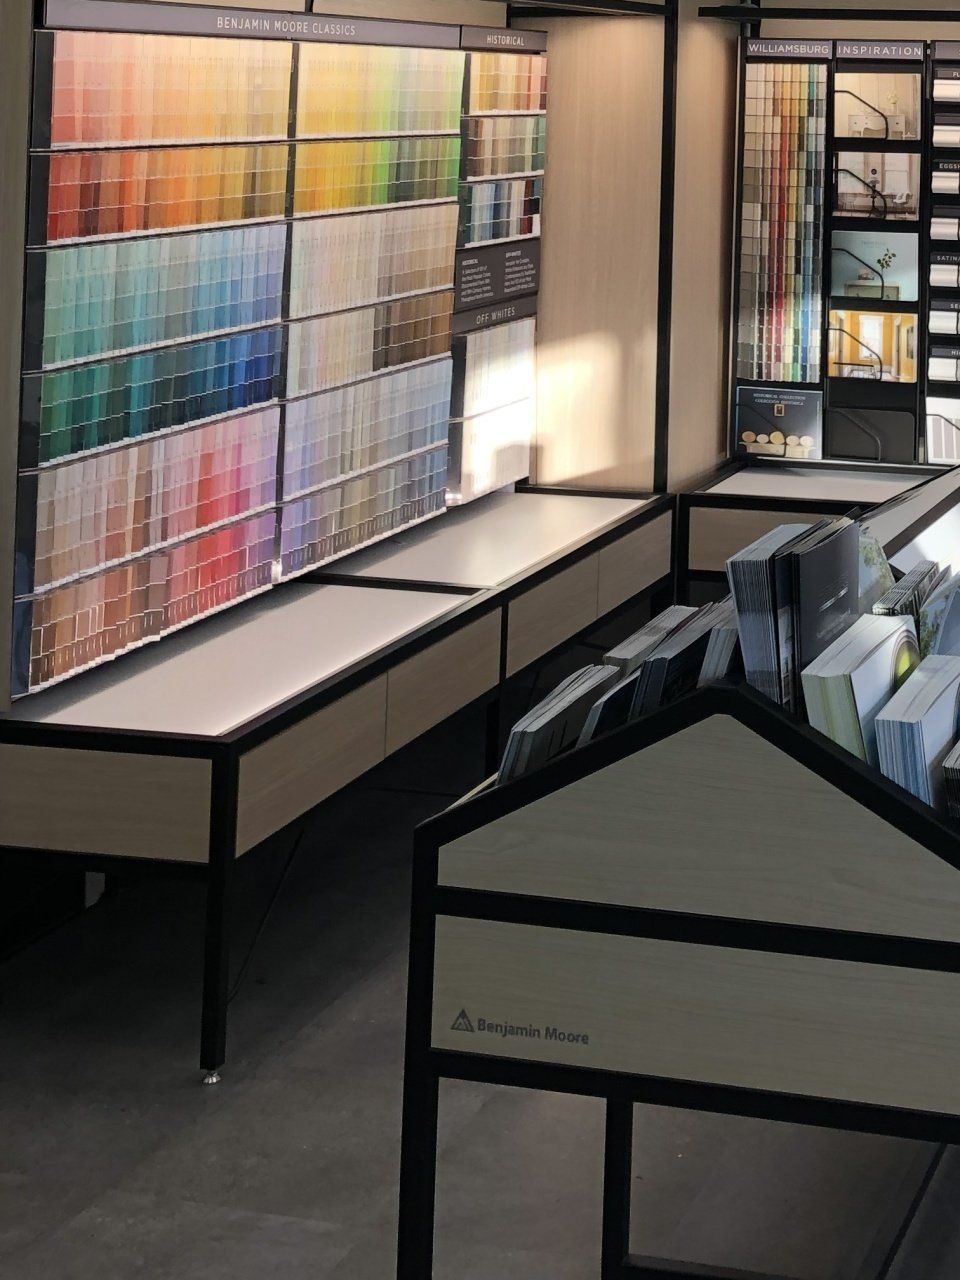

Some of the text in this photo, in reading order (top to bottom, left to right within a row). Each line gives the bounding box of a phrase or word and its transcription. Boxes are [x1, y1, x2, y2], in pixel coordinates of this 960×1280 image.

[217, 16, 356, 36] BENJAMIN MOORE CLASSICS
[486, 34, 525, 46] HISTORICAL
[749, 43, 829, 54] WILLIAMSBURG
[838, 46, 921, 56] INSPIRATION
[476, 307, 515, 325] OFF WHITES
[477, 1018, 589, 1045] Benjamin Moore
